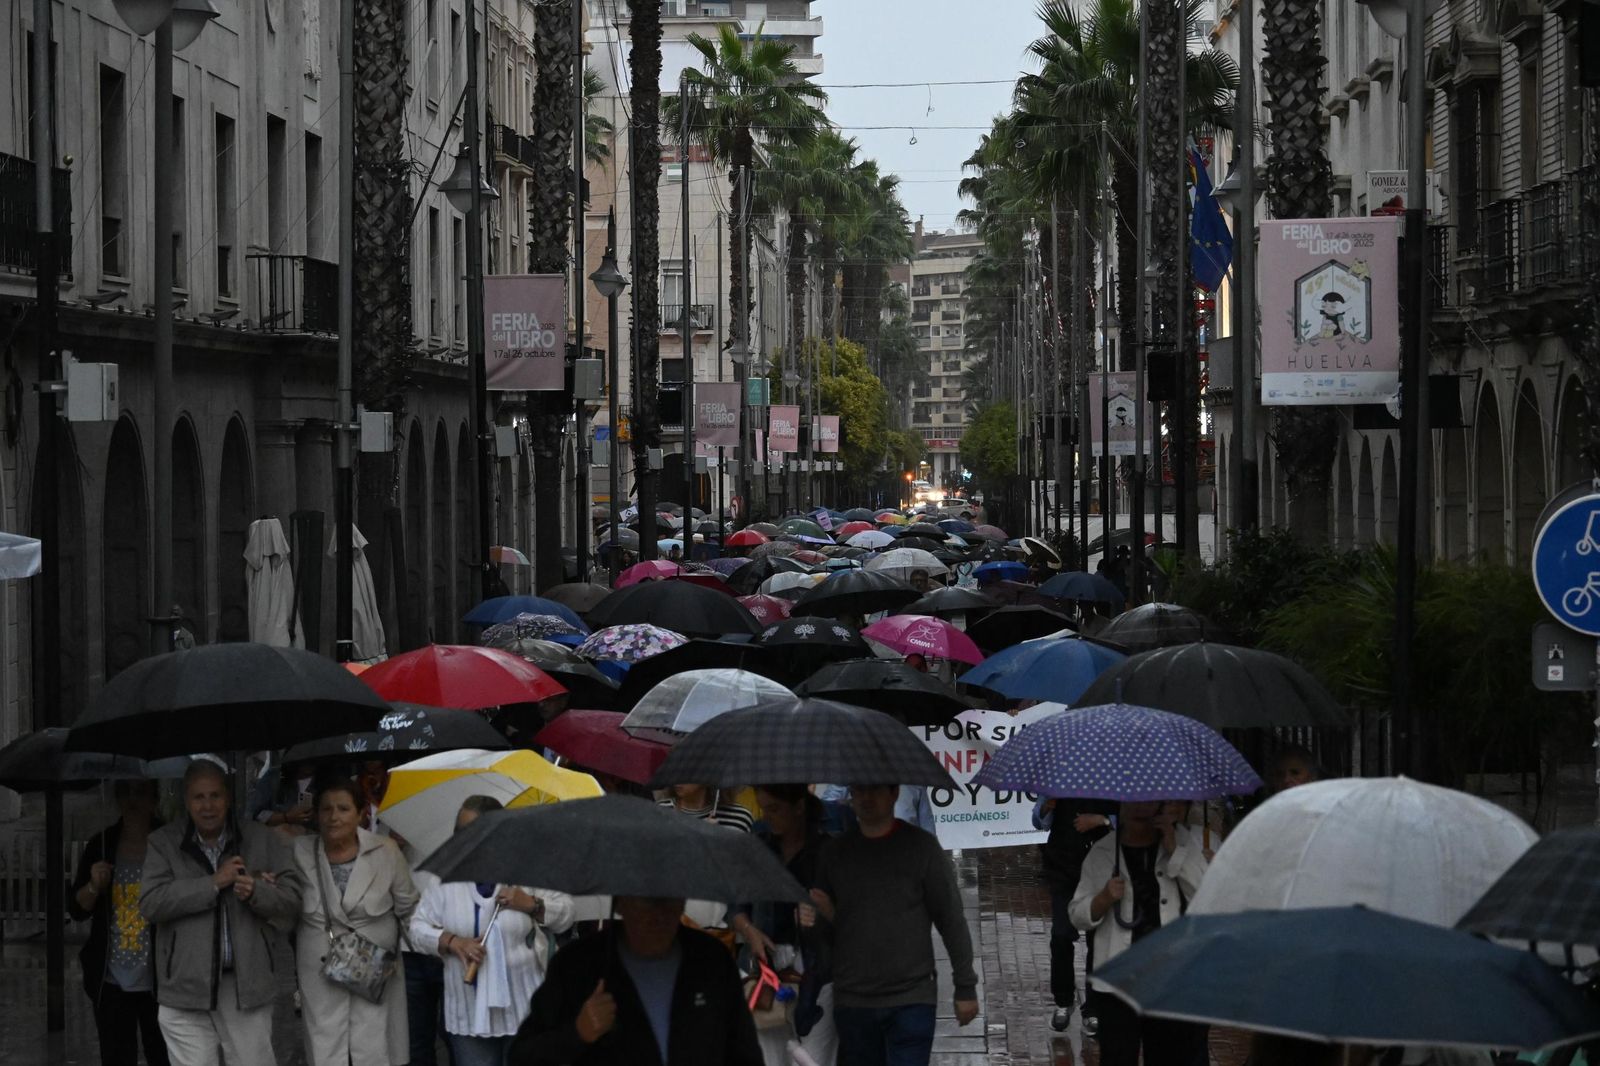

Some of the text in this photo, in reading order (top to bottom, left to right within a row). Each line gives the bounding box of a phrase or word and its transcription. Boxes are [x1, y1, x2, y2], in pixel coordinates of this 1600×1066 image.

[1372, 176, 1406, 187] GOMEZ &
[1282, 224, 1324, 240] FERIA
[1309, 239, 1352, 255] LIBRO
[1354, 238, 1374, 248] 2025
[492, 313, 540, 331] FERIA
[492, 329, 556, 349] del LIBRO
[494, 349, 503, 358] 17
[524, 348, 556, 358] octubre
[1288, 354, 1372, 369] HUELVA
[700, 402, 727, 413] FERIA
[708, 412, 736, 423] LIBRO
[925, 718, 982, 741] POR
[965, 783, 982, 806] Y
[940, 810, 1010, 823] SUCEDÁNEOS!
